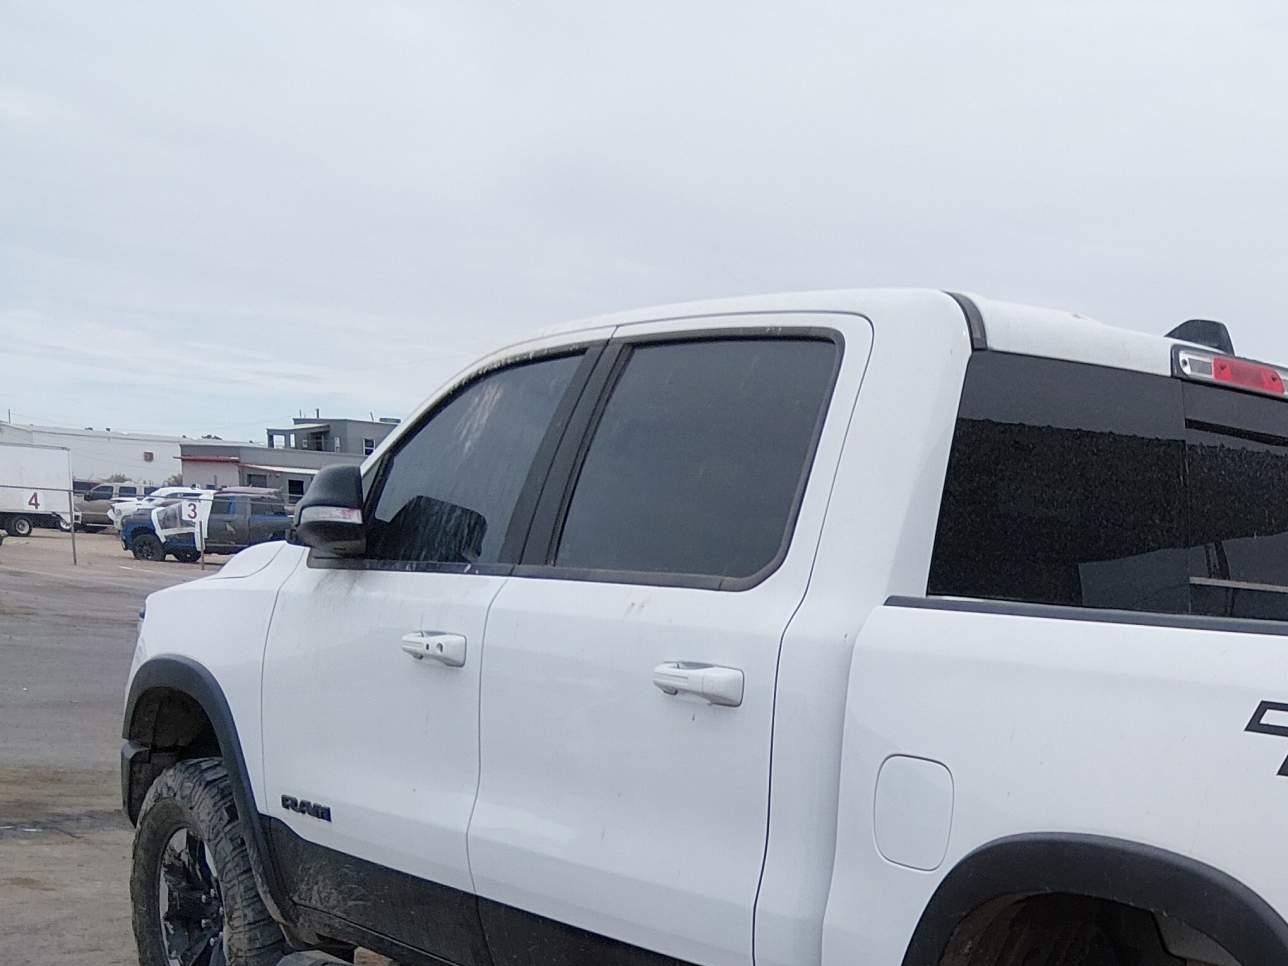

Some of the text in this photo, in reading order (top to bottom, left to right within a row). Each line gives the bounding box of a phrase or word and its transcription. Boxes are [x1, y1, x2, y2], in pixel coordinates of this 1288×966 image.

[27, 492, 41, 510] 4
[187, 503, 198, 520] 3
[280, 794, 332, 823] RAM
